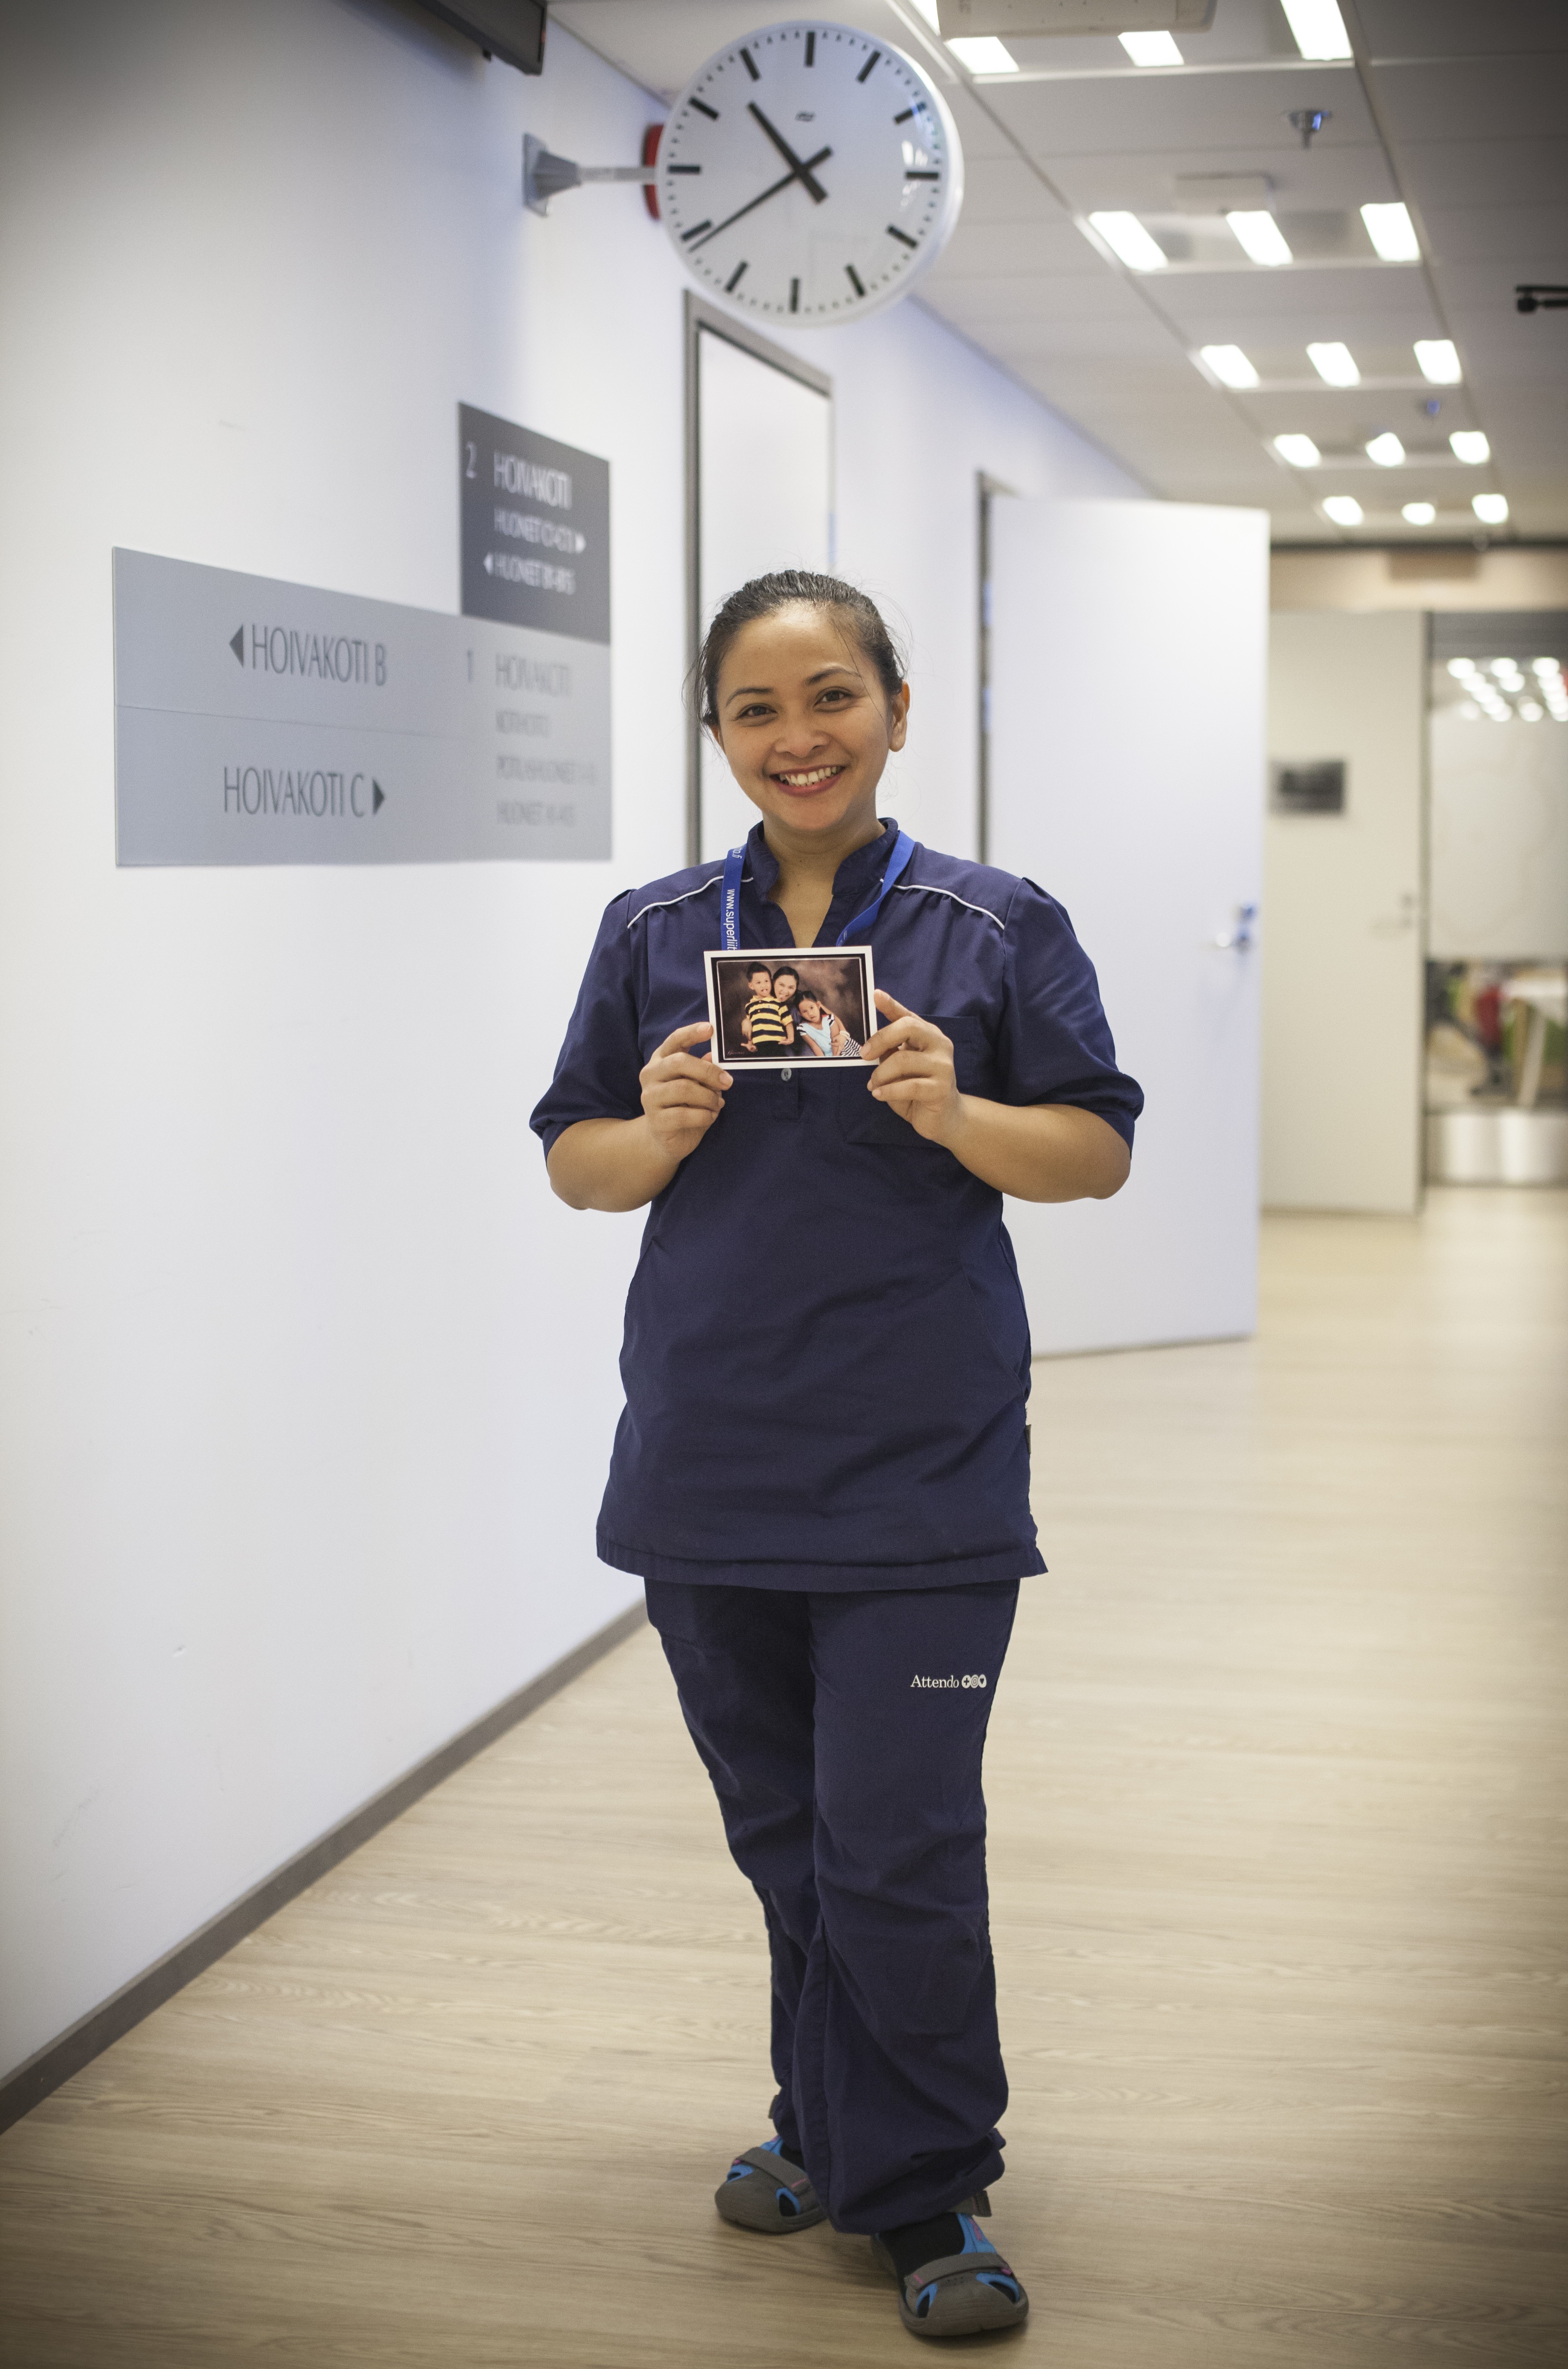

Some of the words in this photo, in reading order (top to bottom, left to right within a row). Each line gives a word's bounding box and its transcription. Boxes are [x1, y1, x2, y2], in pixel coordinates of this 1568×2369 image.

[466, 441, 477, 479] 2
[252, 624, 369, 684] HOIVAKOTI
[375, 643, 386, 687] B
[224, 766, 343, 817] HOIVAKOTI
[350, 772, 365, 818] C
[910, 1675, 959, 1688] Attendo
